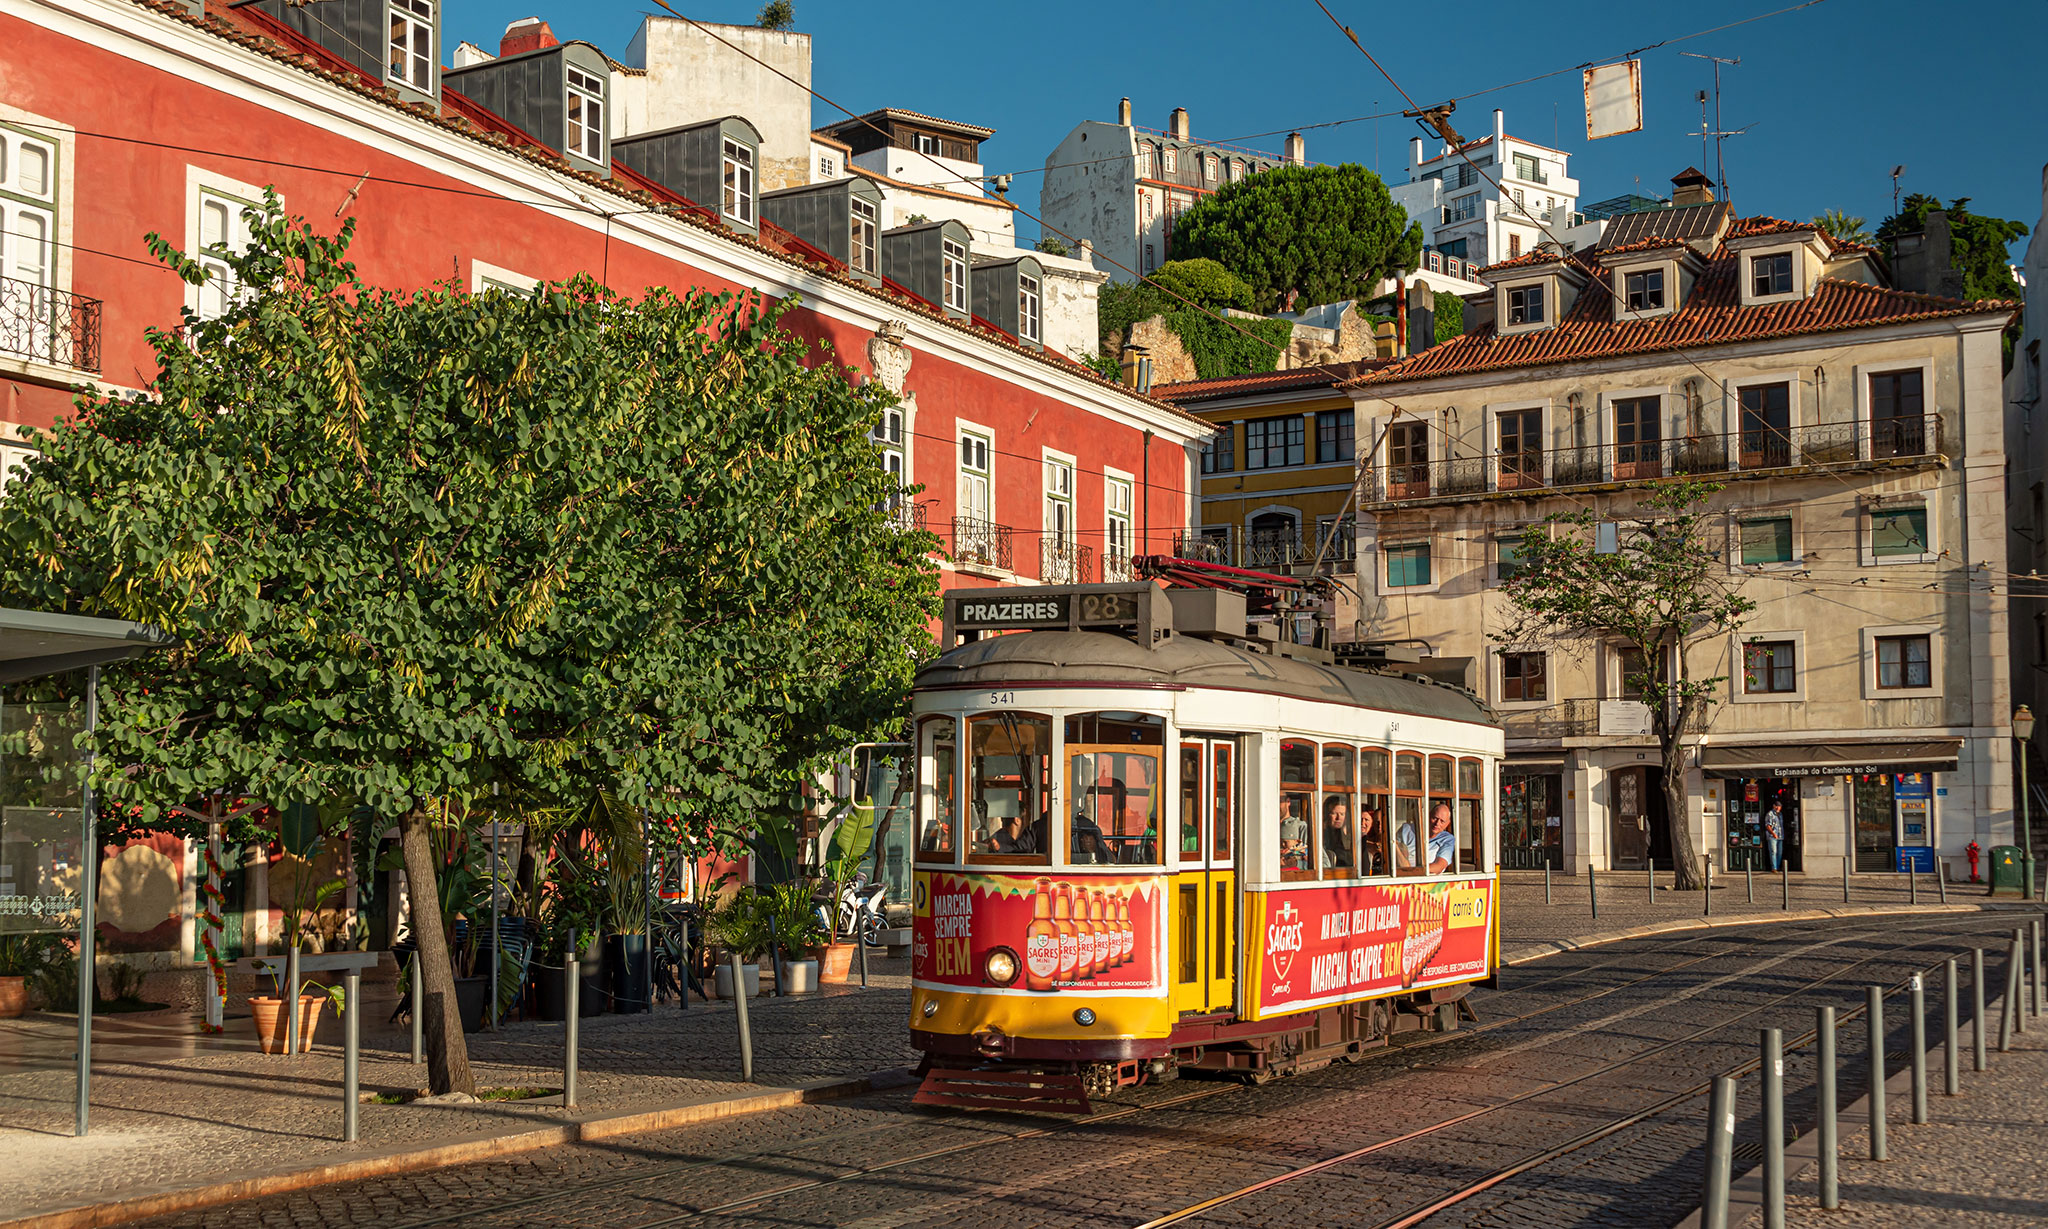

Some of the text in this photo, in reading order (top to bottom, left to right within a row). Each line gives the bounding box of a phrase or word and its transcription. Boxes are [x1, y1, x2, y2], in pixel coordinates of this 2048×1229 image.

[963, 602, 1059, 621] PRAZERES
[1082, 593, 1120, 620] 28
[990, 692, 1014, 704] 541
[1391, 722, 1399, 731] 541
[1774, 768, 1808, 776] Esplanada
[1865, 765, 1877, 773] Sol
[934, 893, 973, 916] MARCHA
[935, 915, 972, 938] SEMPRE
[1321, 914, 1330, 940] NA
[1368, 907, 1377, 932] OU
[1267, 921, 1303, 956] SAGRES
[936, 937, 972, 976] BEM
[1028, 947, 1058, 959] SAGRES
[1310, 940, 1402, 994] MARCHA SEMPRE BEM
